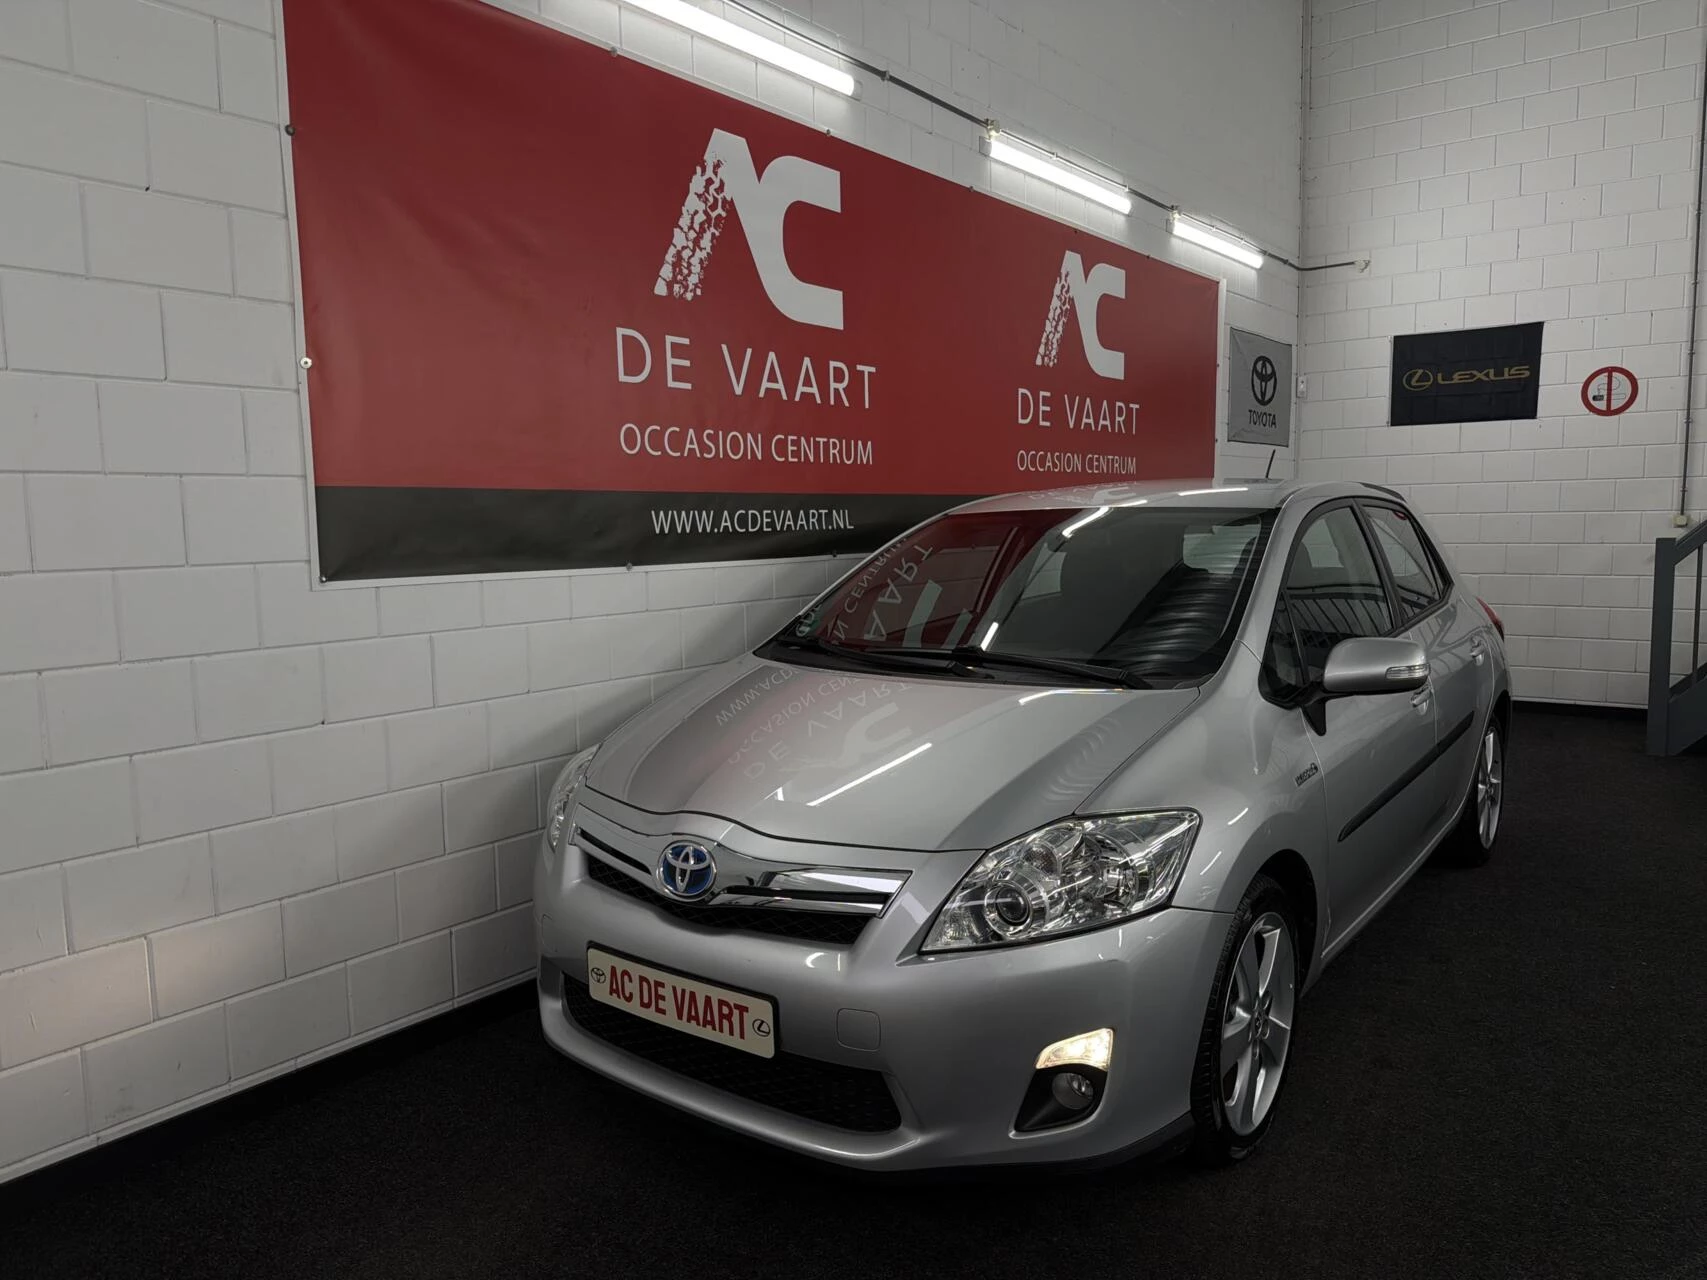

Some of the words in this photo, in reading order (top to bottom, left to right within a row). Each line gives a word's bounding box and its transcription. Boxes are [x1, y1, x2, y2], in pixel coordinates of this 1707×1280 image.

[654, 127, 844, 331] AC
[1035, 250, 1126, 381] AC
[616, 326, 693, 390] DE
[720, 343, 877, 409] VAART
[1438, 365, 1530, 385] LEXUS
[1017, 387, 1052, 428] DE
[1064, 393, 1140, 436] VAART
[1248, 408, 1278, 430] TOYOTA
[619, 422, 763, 461] OCCASION
[770, 433, 874, 465] CENTRUM
[1016, 449, 1082, 474] OCCASION
[1085, 453, 1137, 475] CENTRUM
[650, 508, 855, 535] WWW.ACDEVAART.NL
[609, 965, 634, 1003] AC
[638, 975, 667, 1016] DE
[671, 985, 750, 1041] VAART
